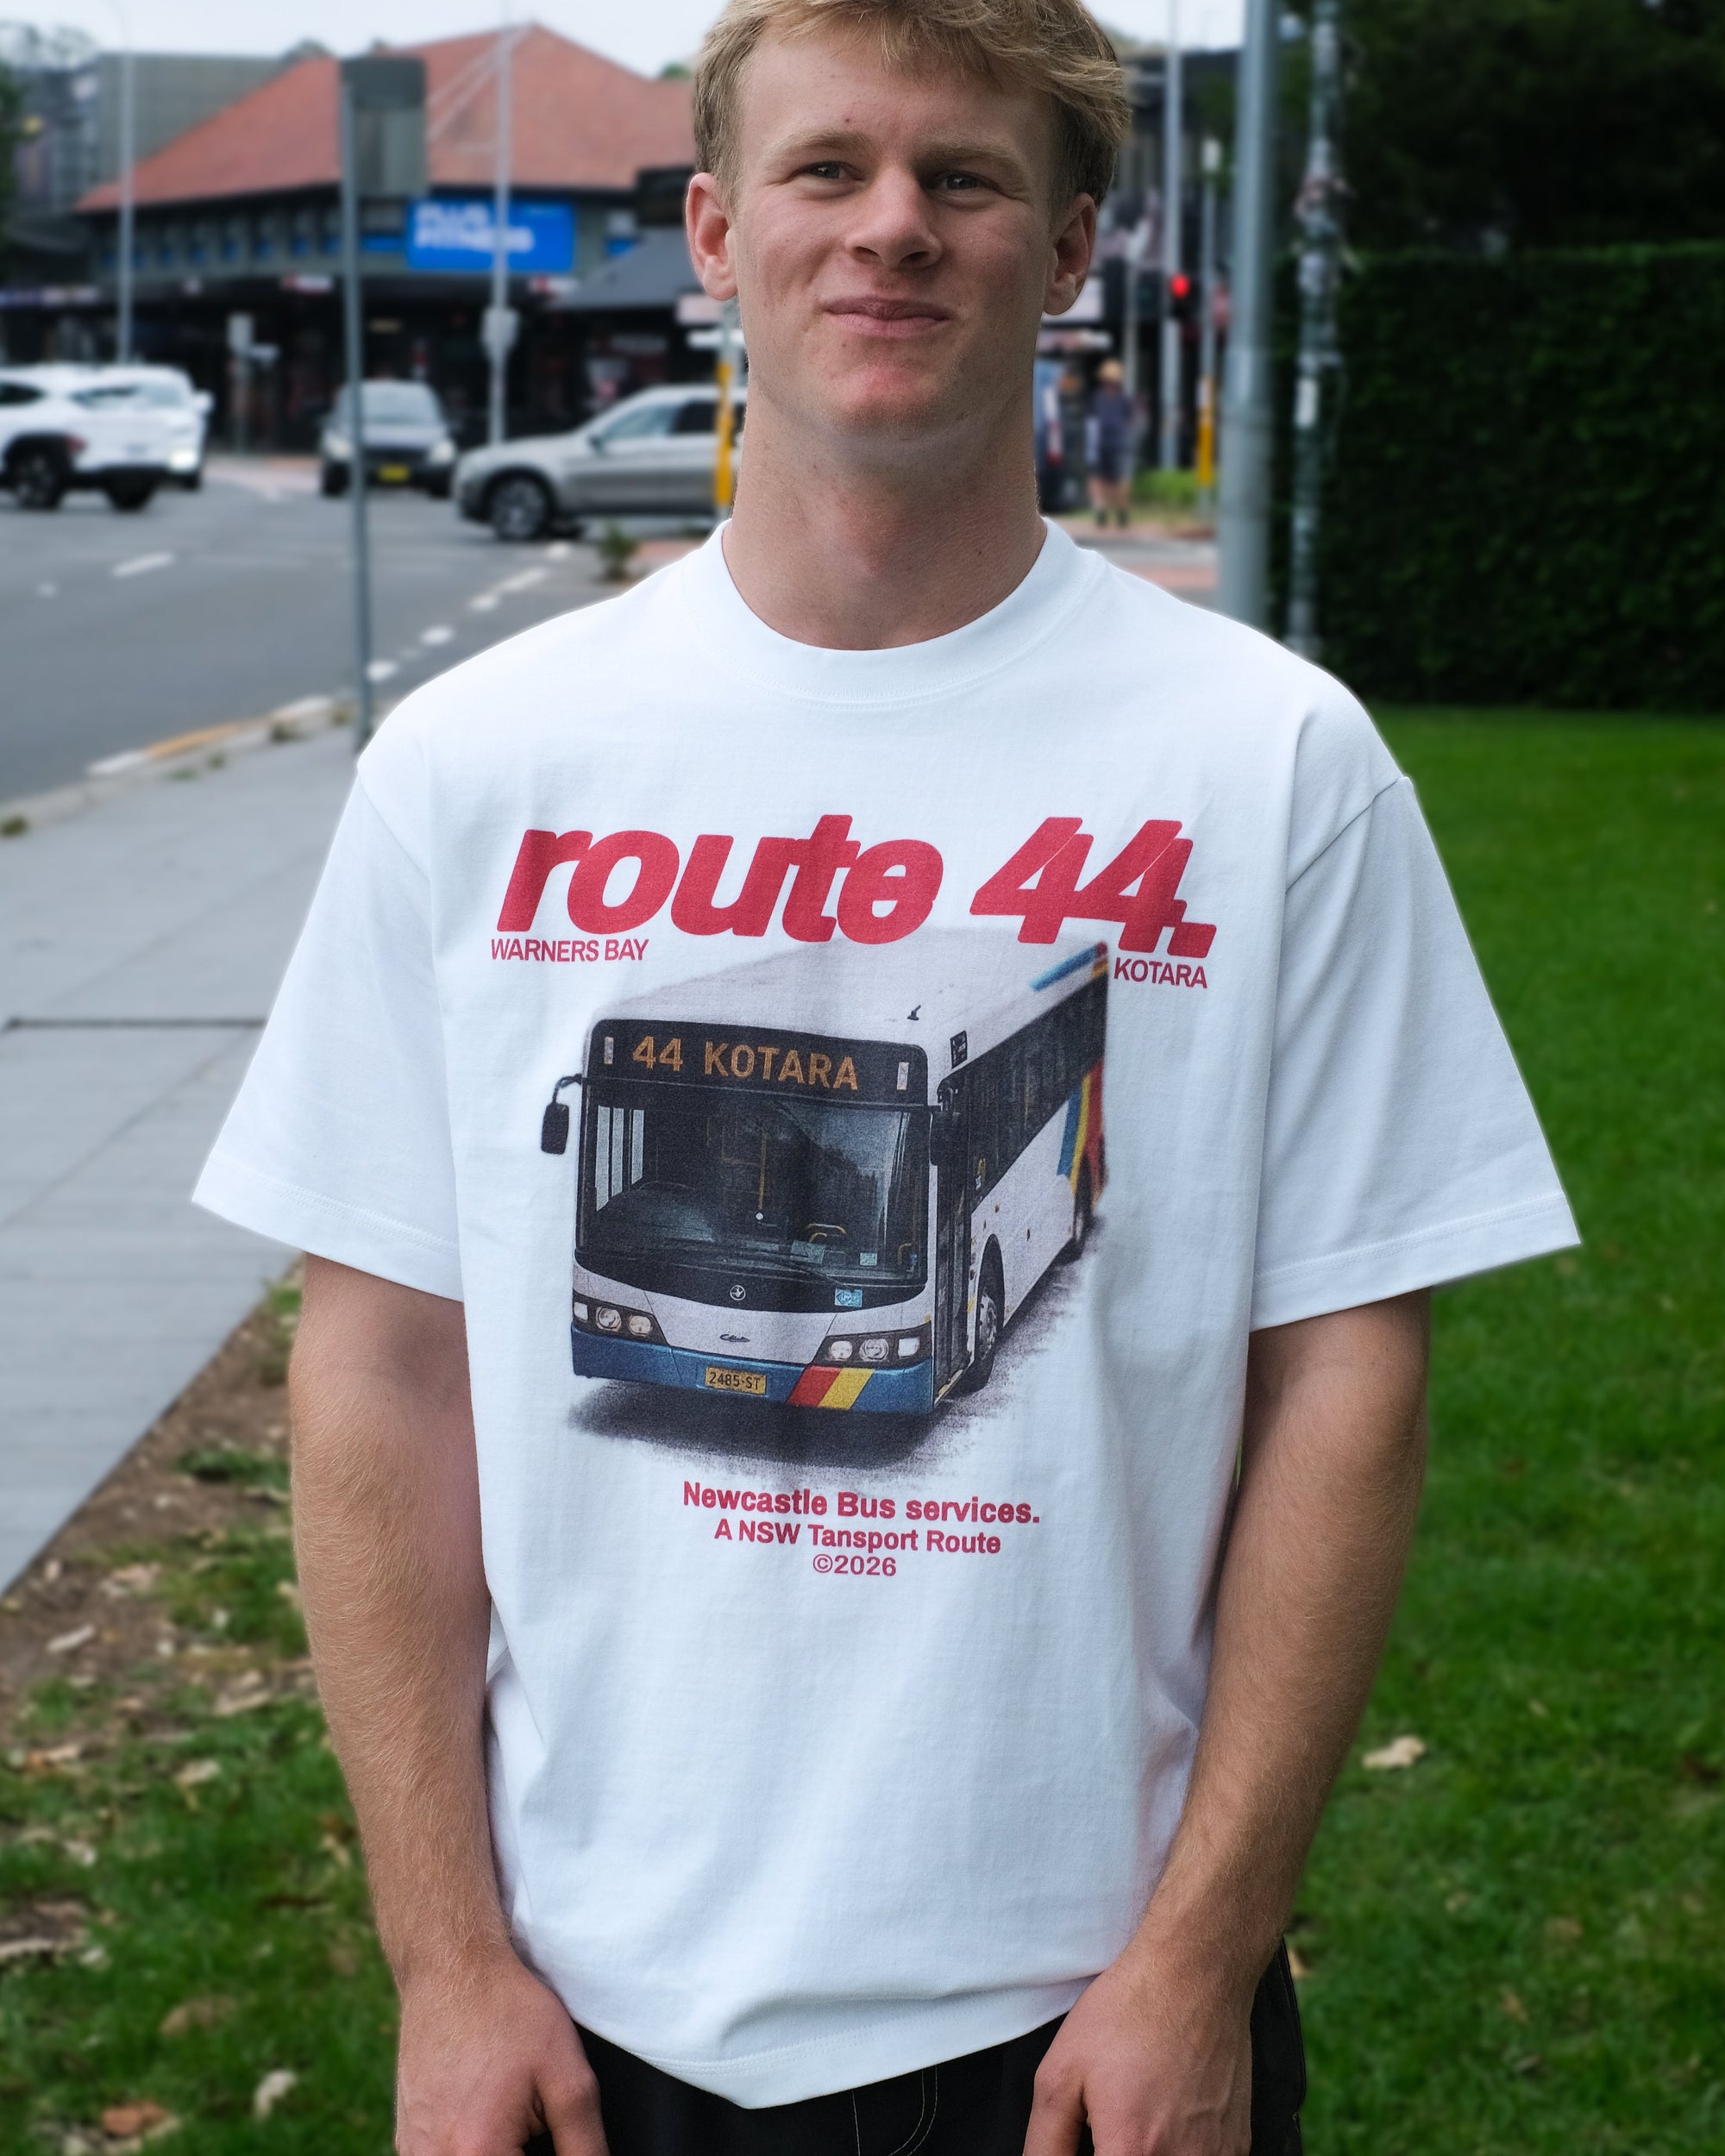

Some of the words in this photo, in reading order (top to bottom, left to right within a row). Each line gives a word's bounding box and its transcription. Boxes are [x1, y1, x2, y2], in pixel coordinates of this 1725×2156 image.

[497, 814, 944, 945] route
[969, 817, 1217, 958] 44.
[491, 938, 599, 962] WARNERS
[604, 938, 649, 962] BAY
[1113, 956, 1208, 989] KOTARA
[632, 1036, 683, 1072] 44
[704, 1040, 858, 1091] KOTARA
[683, 1480, 828, 1516] Newcastle
[837, 1491, 896, 1520] Bus
[906, 1495, 1040, 1524] services.
[713, 1518, 733, 1540] A
[738, 1520, 801, 1545] NSW
[807, 1524, 919, 1553] Tansport
[925, 1529, 1001, 1554] Route
[812, 1552, 897, 1577] ©2026
